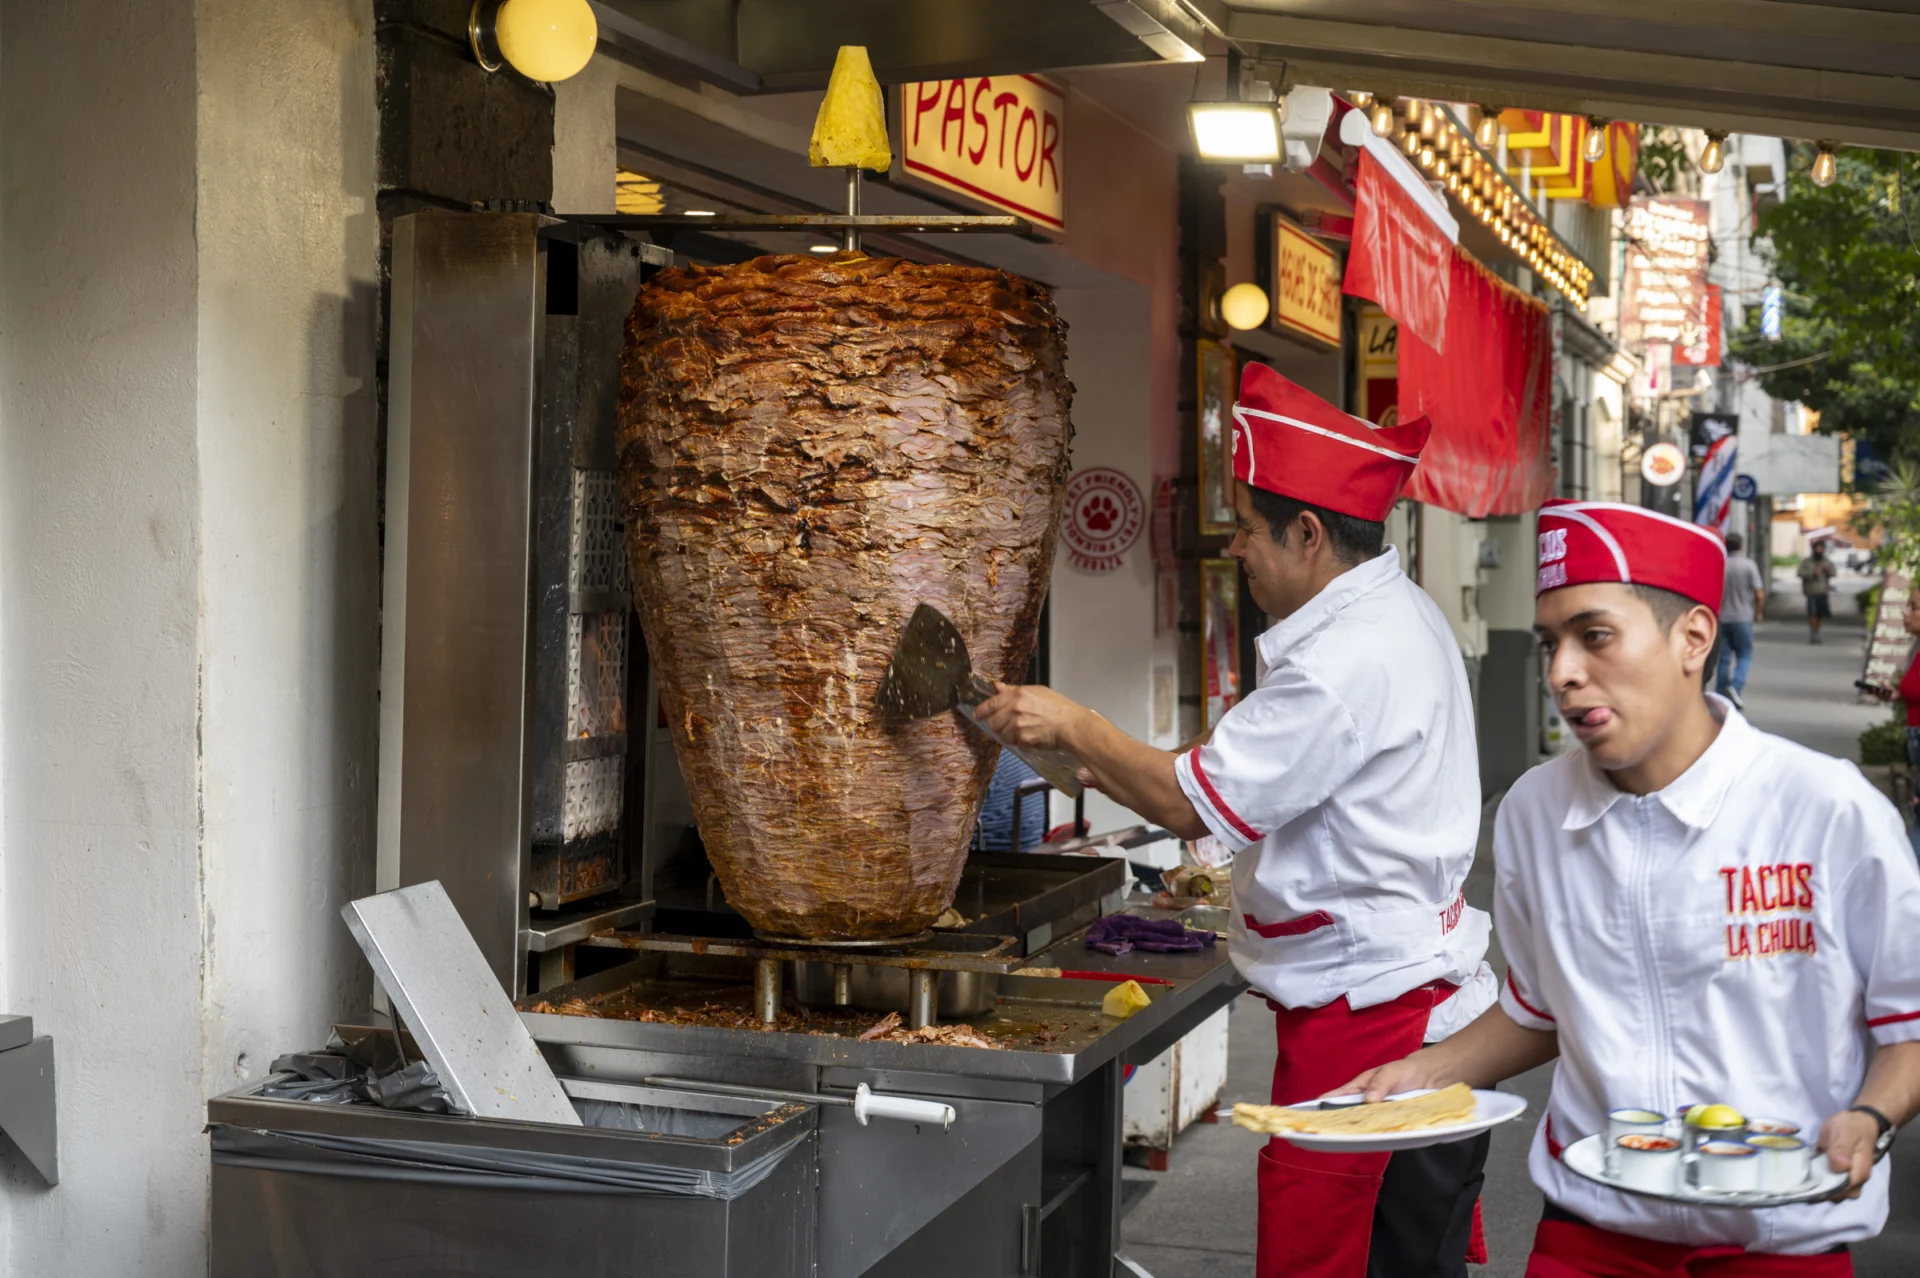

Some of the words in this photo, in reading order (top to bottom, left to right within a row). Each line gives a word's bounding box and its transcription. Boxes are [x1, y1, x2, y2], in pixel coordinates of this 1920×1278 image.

[913, 76, 1059, 193] PASTOR
[1368, 324, 1398, 354] LA
[1085, 474, 1139, 515] FRIENDLY
[1719, 863, 1814, 916] TACOS
[1725, 924, 1752, 962] LA
[1757, 918, 1817, 960] CHULA
